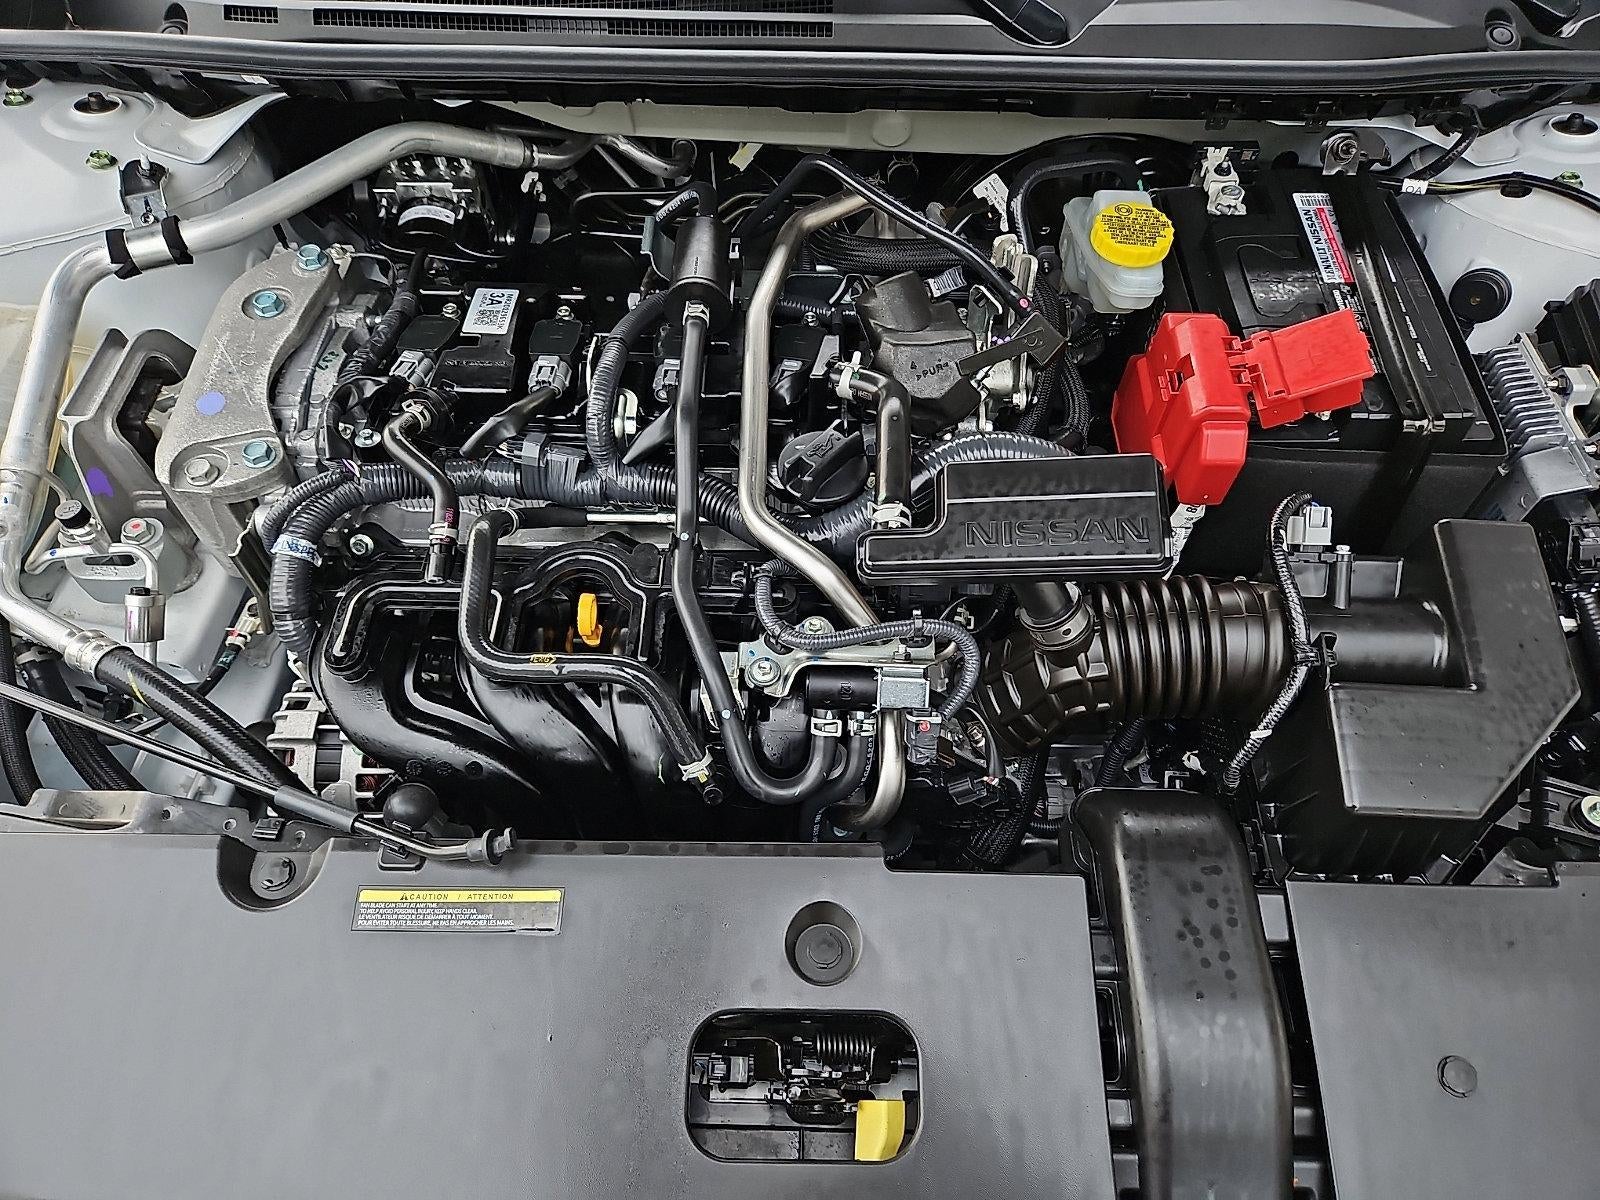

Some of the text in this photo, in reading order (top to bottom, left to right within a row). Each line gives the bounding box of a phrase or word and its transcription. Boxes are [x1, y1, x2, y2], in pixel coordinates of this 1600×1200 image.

[1302, 208, 1324, 245] NISSAN
[486, 292, 505, 306] 3A
[964, 518, 1150, 548] NISSAN
